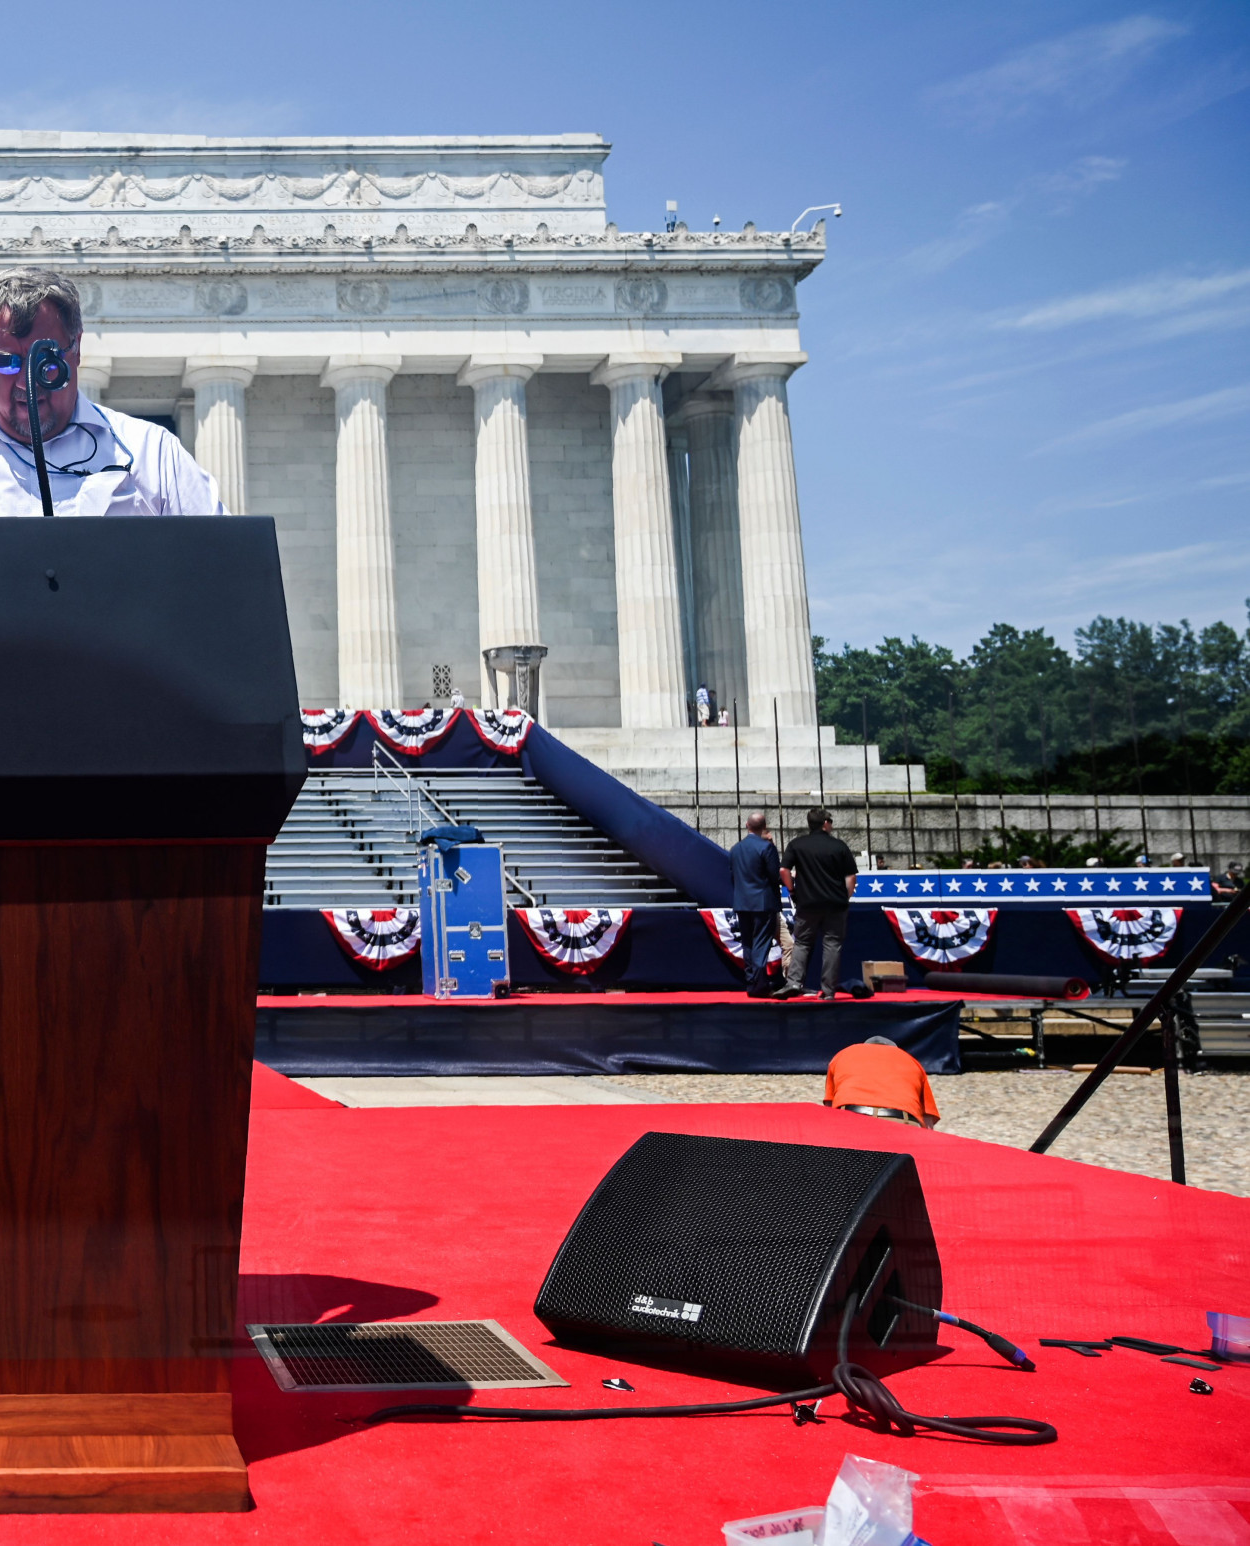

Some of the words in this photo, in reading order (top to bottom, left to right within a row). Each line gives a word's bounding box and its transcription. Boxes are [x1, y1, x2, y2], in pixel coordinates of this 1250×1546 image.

[23, 217, 77, 227] OREGON
[90, 216, 139, 227] KANSAS
[150, 216, 181, 227] WEST
[188, 216, 246, 226] VIRGINIA
[259, 215, 308, 226] NEVADA
[321, 215, 384, 225] NEBRASKA
[398, 214, 469, 225] COLORADO
[481, 214, 525, 224] NORTH
[533, 214, 580, 224] DAKOTA
[537, 286, 607, 299] VIRGINIA
[634, 1294, 654, 1306] d&b
[631, 1304, 680, 1319] audiotechnik
